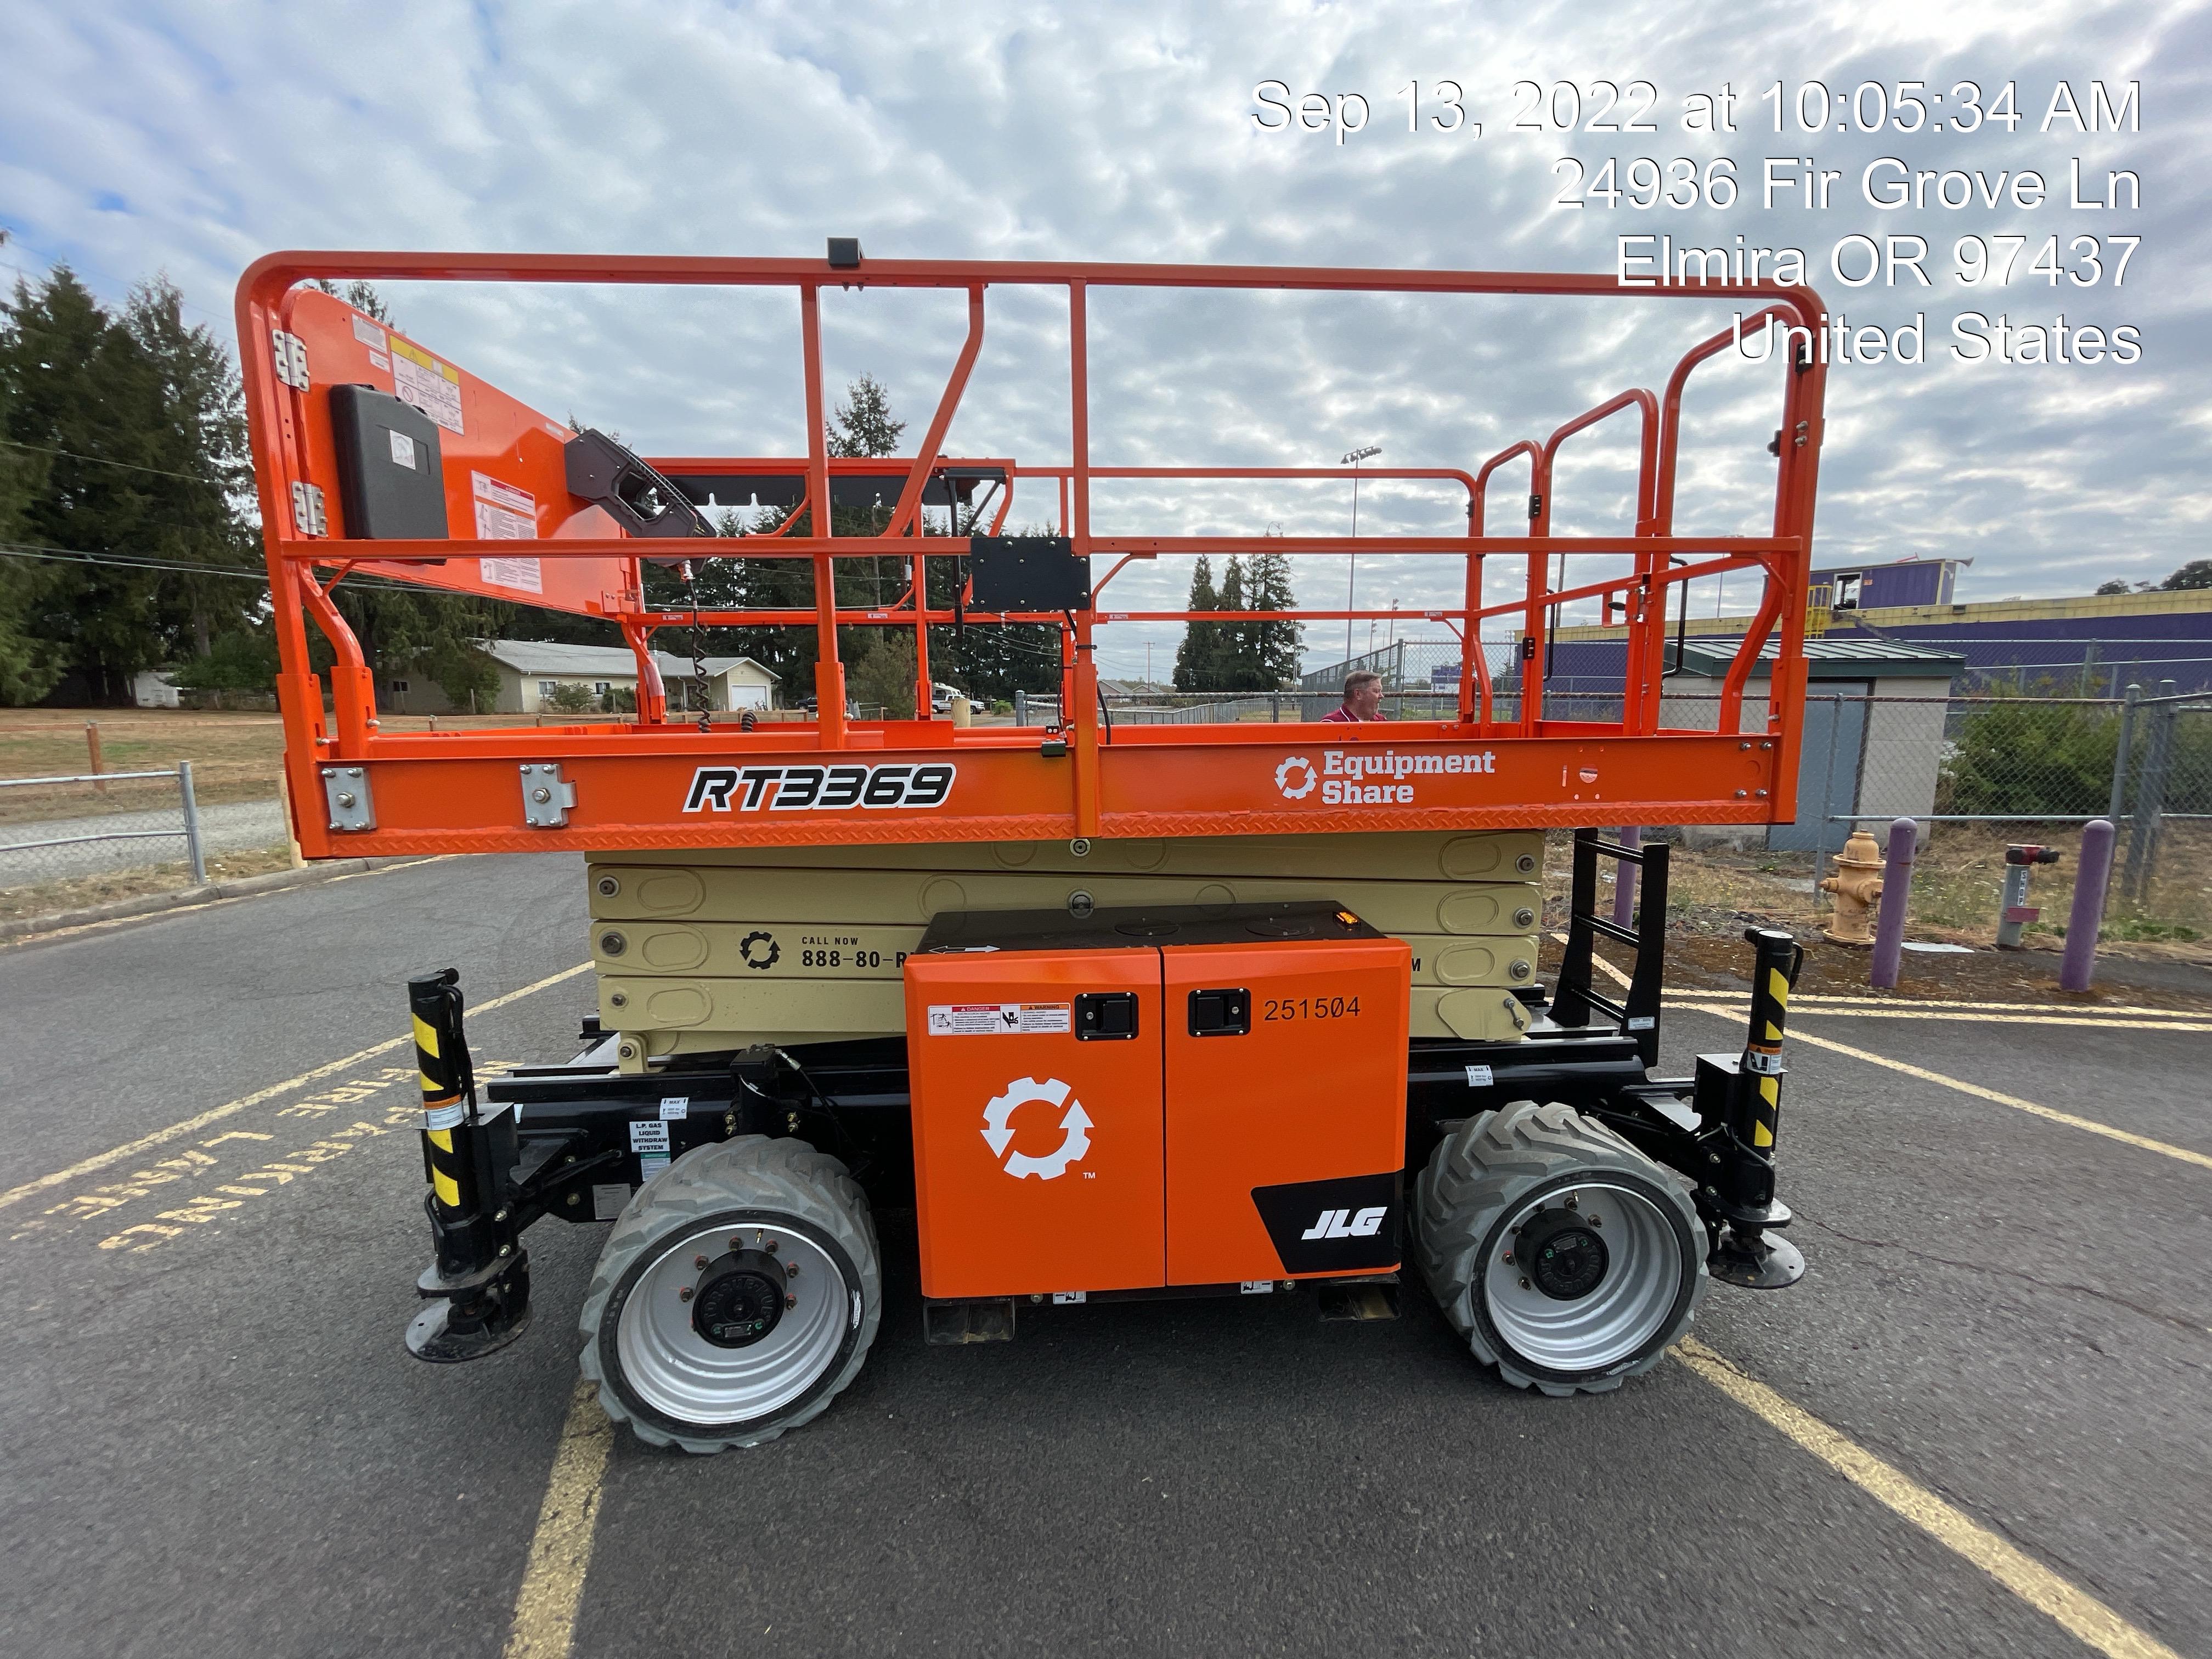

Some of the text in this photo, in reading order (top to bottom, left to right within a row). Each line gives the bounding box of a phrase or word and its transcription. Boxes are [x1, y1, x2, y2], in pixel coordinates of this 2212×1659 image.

[1323, 750, 1496, 780] Equipment
[682, 763, 957, 813] RT3369
[1322, 780, 1414, 804] Share
[802, 936, 859, 945] CALL NOW
[802, 950, 915, 968] 888-80-R
[1265, 996, 1361, 1020] 251504
[276, 1068, 420, 1119] FIRE
[1301, 1207, 1387, 1240] JLG
